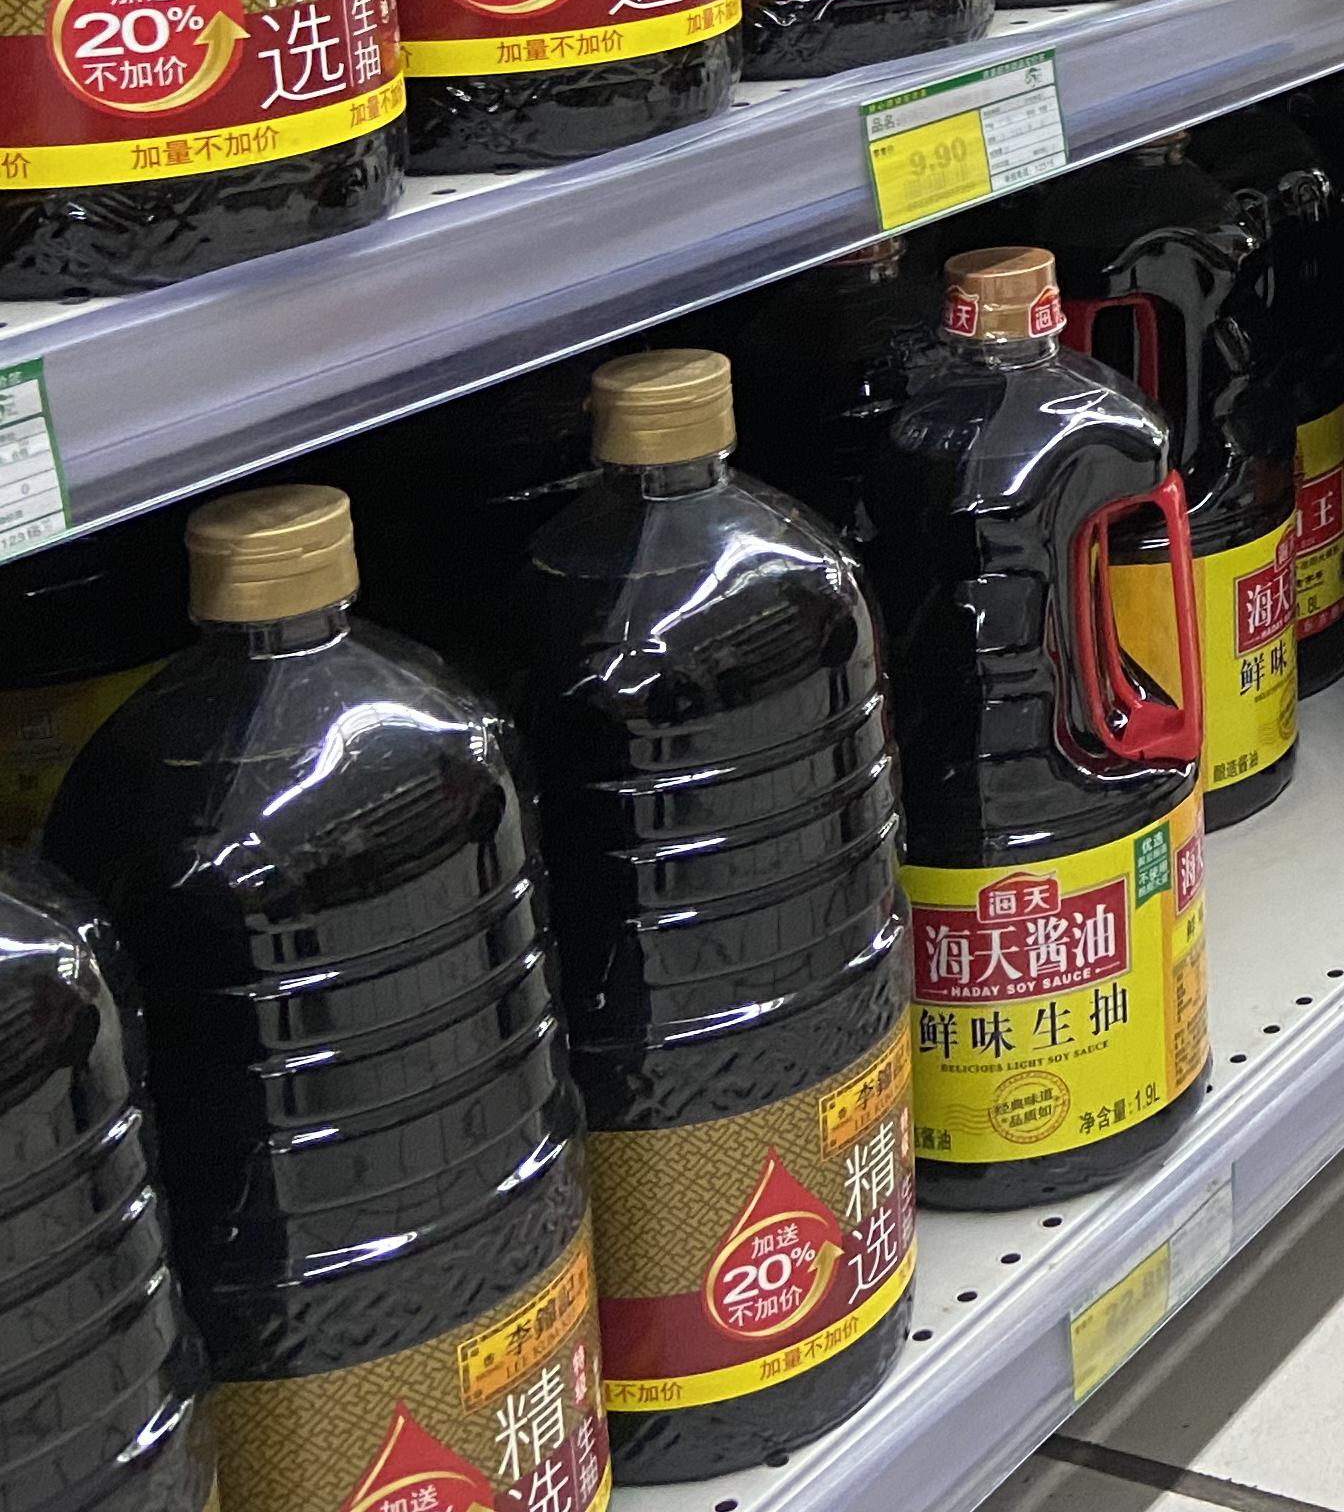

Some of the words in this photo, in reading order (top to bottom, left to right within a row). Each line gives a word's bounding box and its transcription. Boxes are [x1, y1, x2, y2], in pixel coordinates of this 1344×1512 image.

[72, 3, 206, 59] 20%
[496, 29, 625, 66] 加量不加价
[83, 54, 189, 94] 不加价
[1, 152, 32, 180] 价
[131, 125, 281, 171] 加量不加价
[908, 135, 968, 178] 9.90
[1239, 639, 1289, 697] 鲜味
[988, 883, 1052, 918] 海天
[925, 902, 1117, 986] 海天酱油
[950, 983, 1000, 999] HADAY
[1006, 979, 1038, 996] SOY
[1042, 967, 1093, 990] SAUCE
[918, 981, 1130, 1062] 鲜味生抽
[939, 1062, 1004, 1075] DELICIOUS
[1004, 1057, 1046, 1072] LIGHT
[1047, 1053, 1073, 1066] SOY
[1072, 1039, 1111, 1060] SAUCE
[1078, 1083, 1161, 1135] 净含量:1.9L
[843, 1118, 900, 1306] 精选
[750, 1221, 801, 1261] 加送
[722, 1243, 817, 1306] 20%
[727, 1285, 804, 1328] 不加价
[758, 1313, 862, 1382] 加量不加价
[576, 1415, 600, 1504] 生抽
